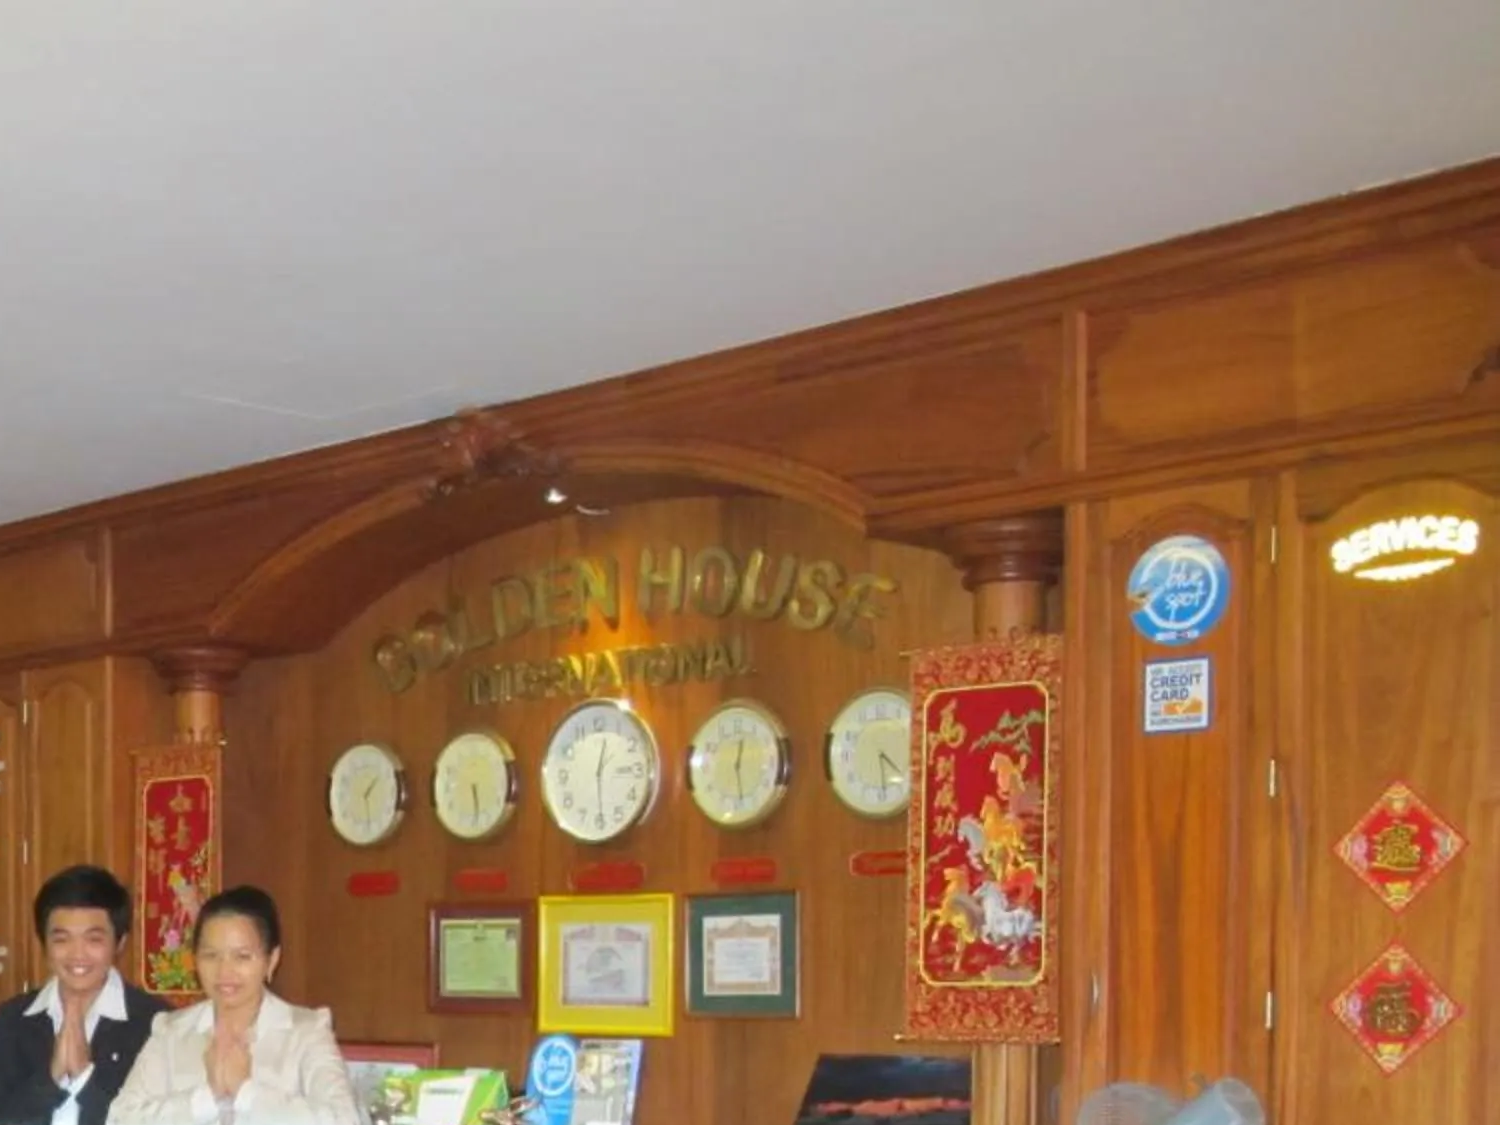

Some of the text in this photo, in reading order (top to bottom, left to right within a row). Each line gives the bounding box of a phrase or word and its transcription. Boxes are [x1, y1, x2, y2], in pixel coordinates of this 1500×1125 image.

[1330, 514, 1480, 573] SERVICES
[637, 546, 898, 650] HOUSE
[1150, 672, 1203, 689] CREDIT
[1150, 687, 1189, 703] CARD
